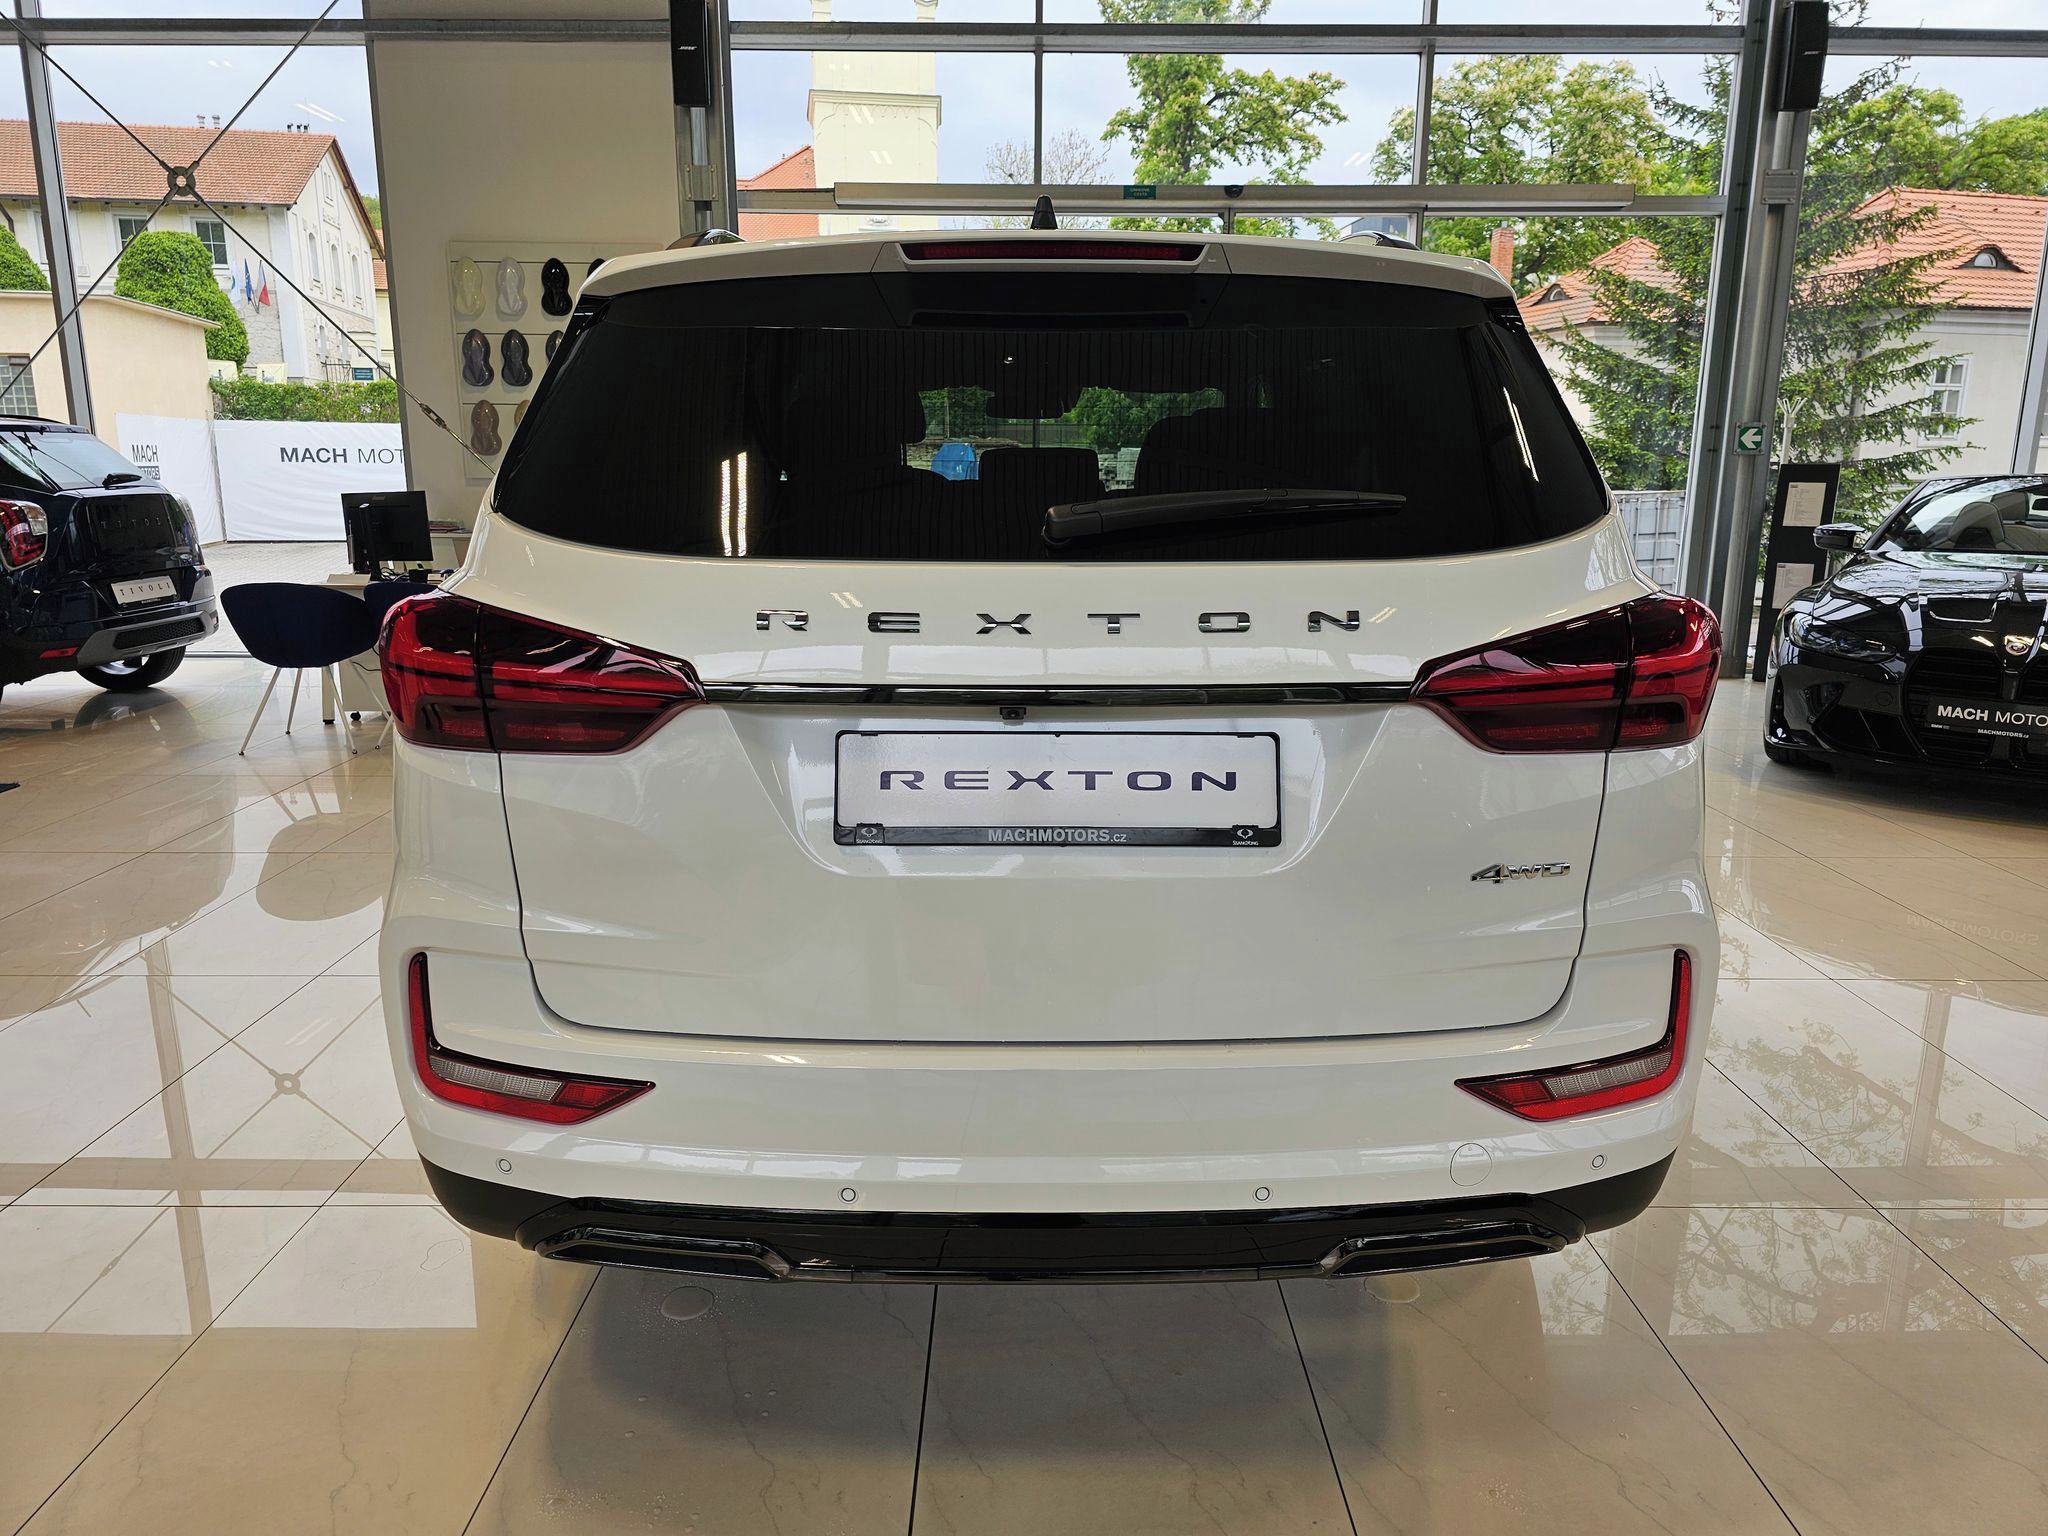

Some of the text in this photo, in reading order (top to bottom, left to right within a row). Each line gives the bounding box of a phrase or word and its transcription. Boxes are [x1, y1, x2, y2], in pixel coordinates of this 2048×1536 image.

[131, 444, 159, 462] MACH
[280, 447, 348, 463] MACH
[120, 582, 171, 596] TIVOLI
[756, 608, 1360, 635] REXTON
[1937, 705, 2048, 727] MACH MOTO
[879, 770, 1237, 792] REXTON
[1470, 862, 1571, 884] 4WD
